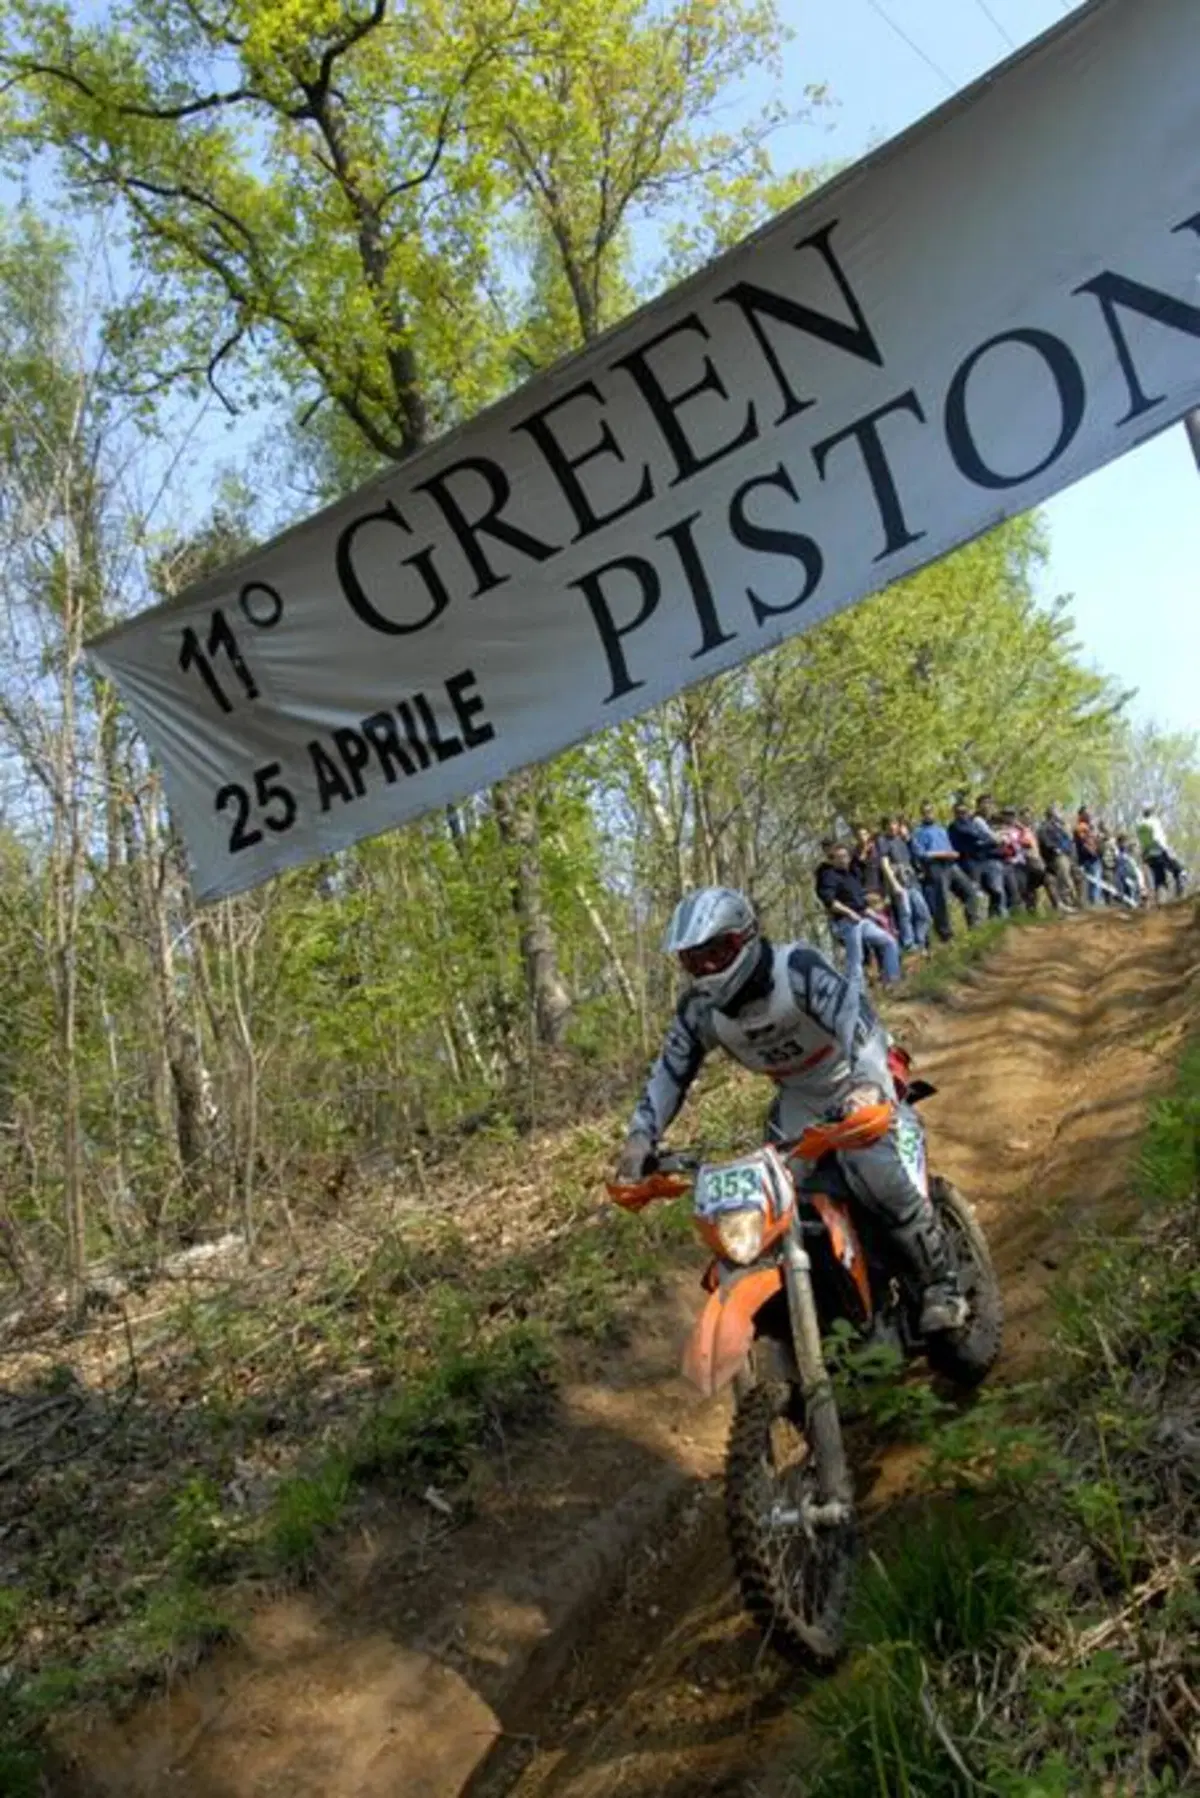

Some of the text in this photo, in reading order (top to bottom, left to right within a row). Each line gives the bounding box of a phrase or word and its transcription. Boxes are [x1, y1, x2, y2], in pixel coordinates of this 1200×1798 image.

[336, 219, 885, 636] GREEN
[214, 669, 496, 854] 25 APRILE
[707, 1167, 758, 1204] 353
